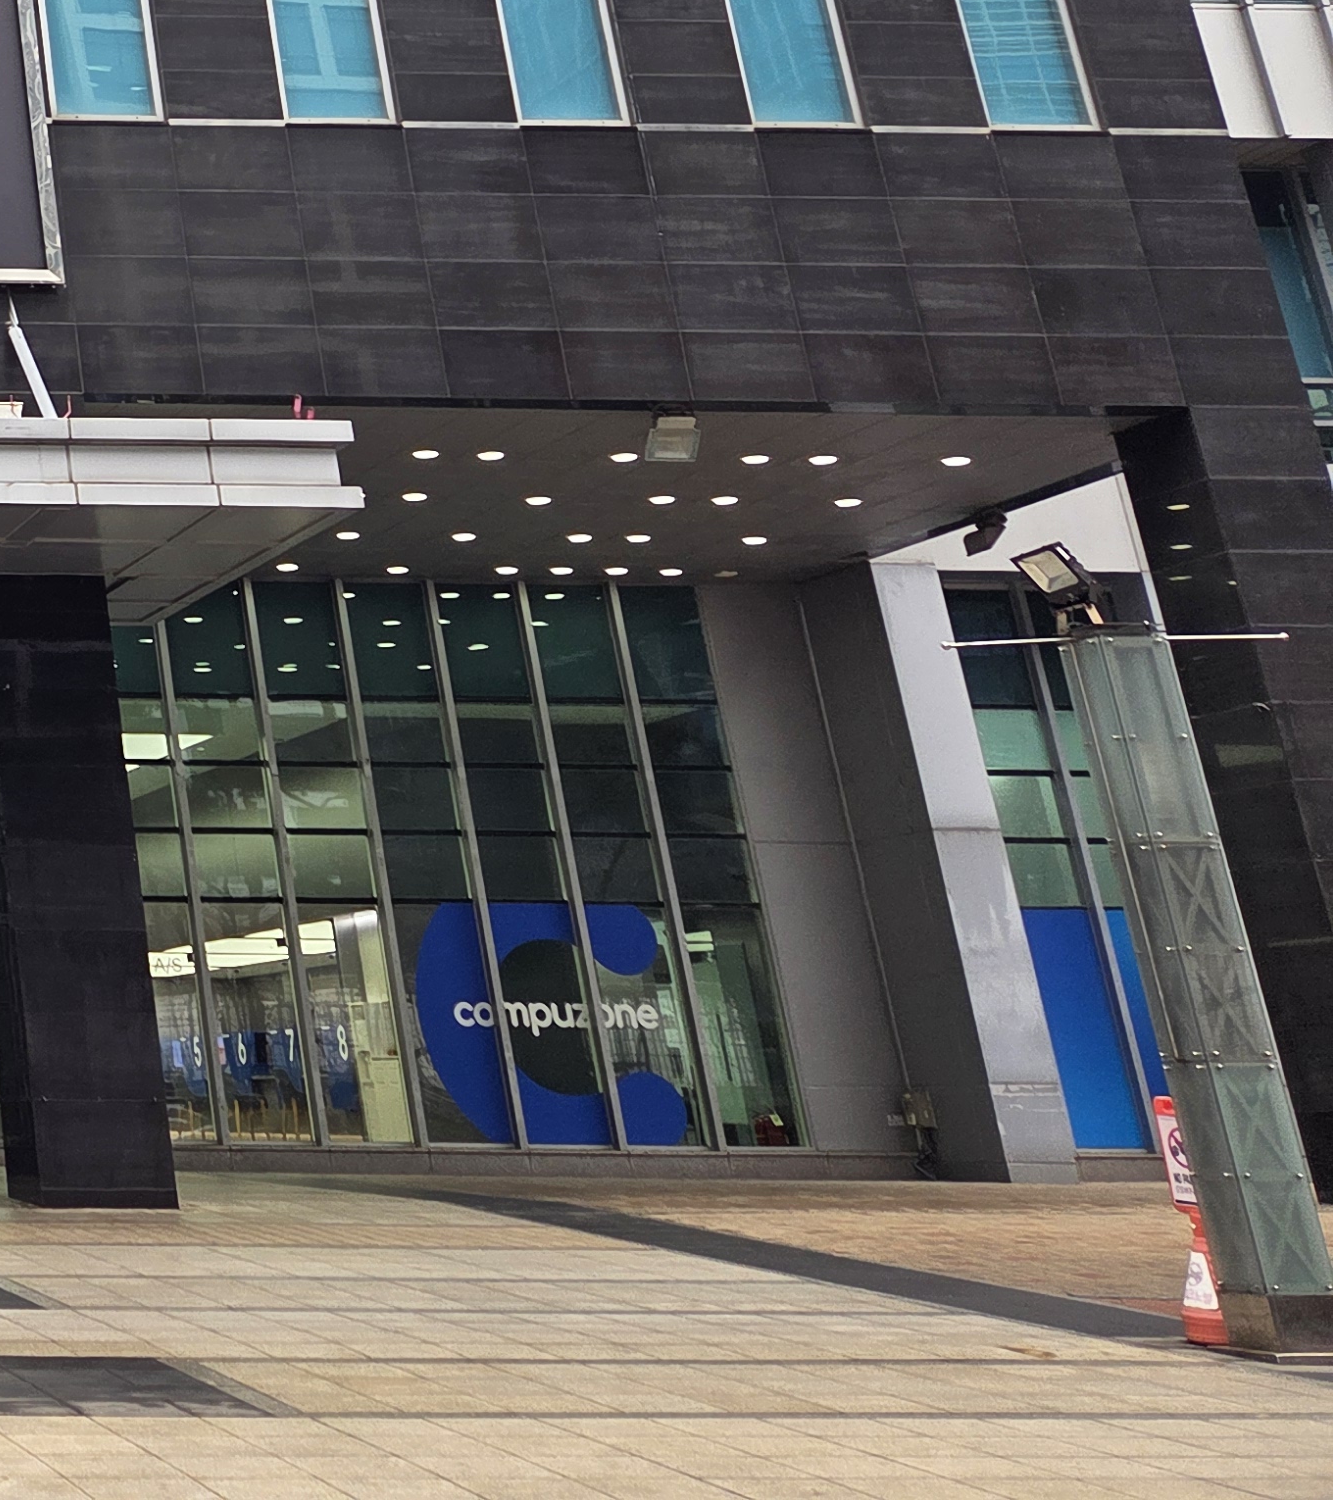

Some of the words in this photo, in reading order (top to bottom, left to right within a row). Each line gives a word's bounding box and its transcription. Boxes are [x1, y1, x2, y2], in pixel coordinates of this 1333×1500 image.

[154, 957, 183, 974] A/S
[192, 1036, 202, 1068] 5
[237, 1032, 247, 1066] 6
[285, 1028, 294, 1062] 7
[336, 1024, 348, 1062] 8
